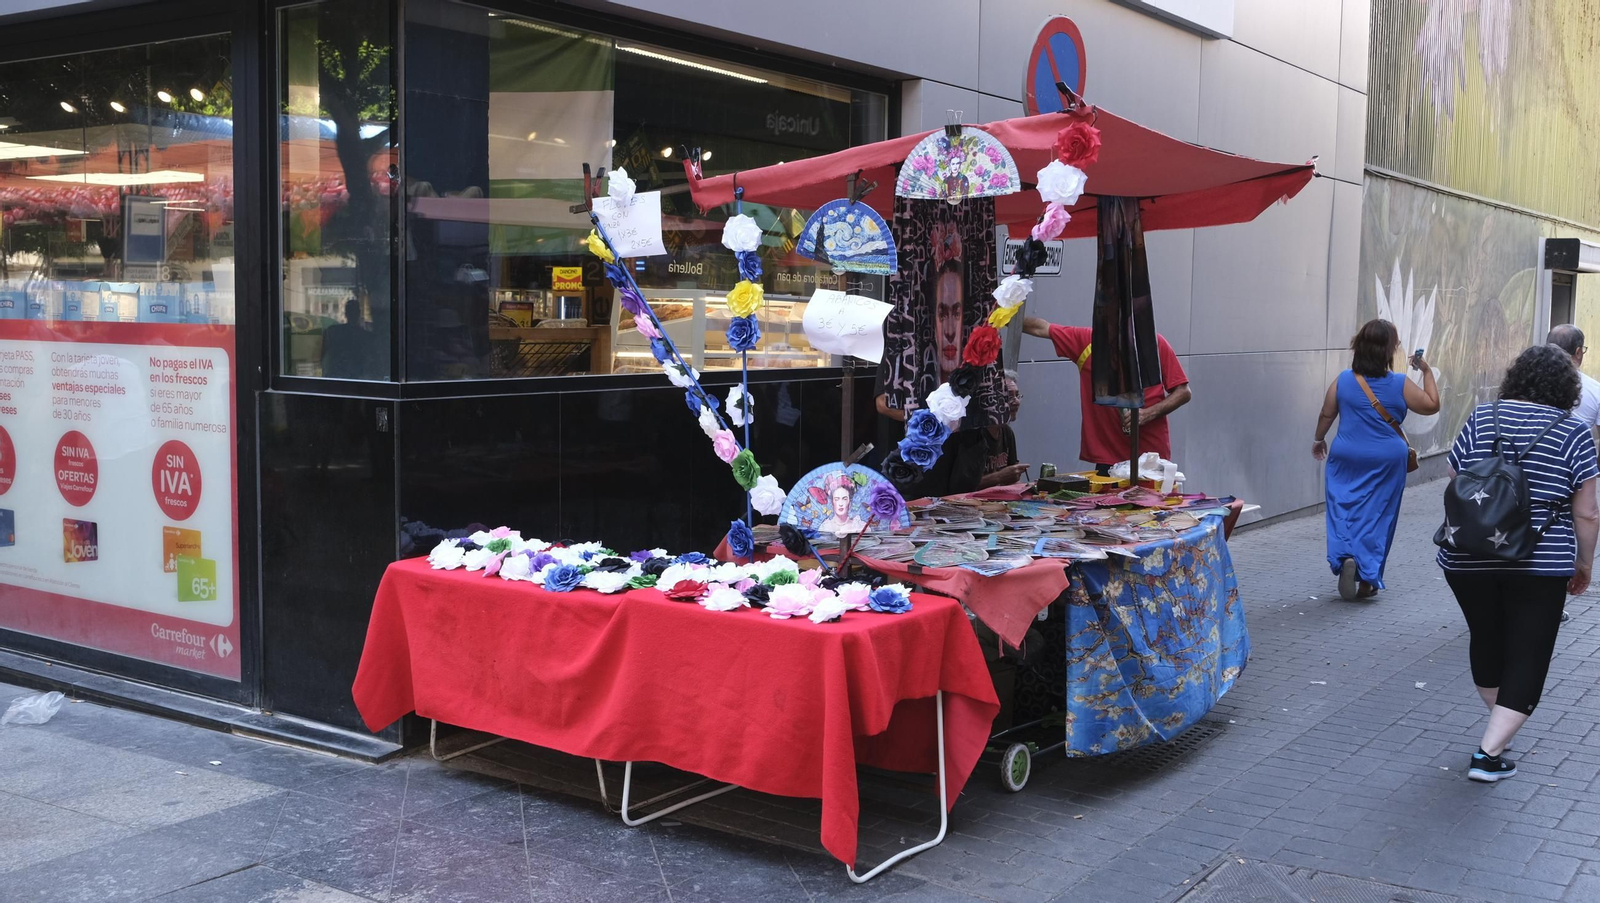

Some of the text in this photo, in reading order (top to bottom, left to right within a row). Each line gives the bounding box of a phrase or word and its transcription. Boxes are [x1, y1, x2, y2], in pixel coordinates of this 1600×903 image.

[602, 196, 646, 211] FLOES
[612, 212, 629, 220] CON
[554, 281, 583, 290] PROMO
[150, 305, 167, 313] CHUFA
[849, 323, 868, 336] 5€
[15, 349, 35, 362] PASS,
[51, 351, 66, 363] Con
[66, 352, 73, 364] la
[74, 354, 98, 367] tarjeta
[4, 365, 34, 376] compras
[149, 356, 214, 372] No pagas el IVA
[51, 366, 119, 381] obtendrás muchas
[149, 371, 208, 386] en los frescos
[51, 380, 126, 396] ventajas especiales
[149, 386, 202, 403] si eres mayor
[52, 396, 101, 409] para menores
[150, 402, 194, 416] de 65 años
[52, 408, 92, 422] de 30 años
[157, 416, 184, 430] familia
[184, 421, 227, 434] numerosa
[61, 445, 89, 459] SIN IVA
[166, 454, 184, 469] SIN
[58, 469, 95, 485] OFERTAS
[164, 496, 188, 508] frescos
[68, 540, 98, 558] Joven
[191, 577, 216, 599] 65+
[151, 622, 206, 648] Carrefour
[175, 645, 206, 660] market
